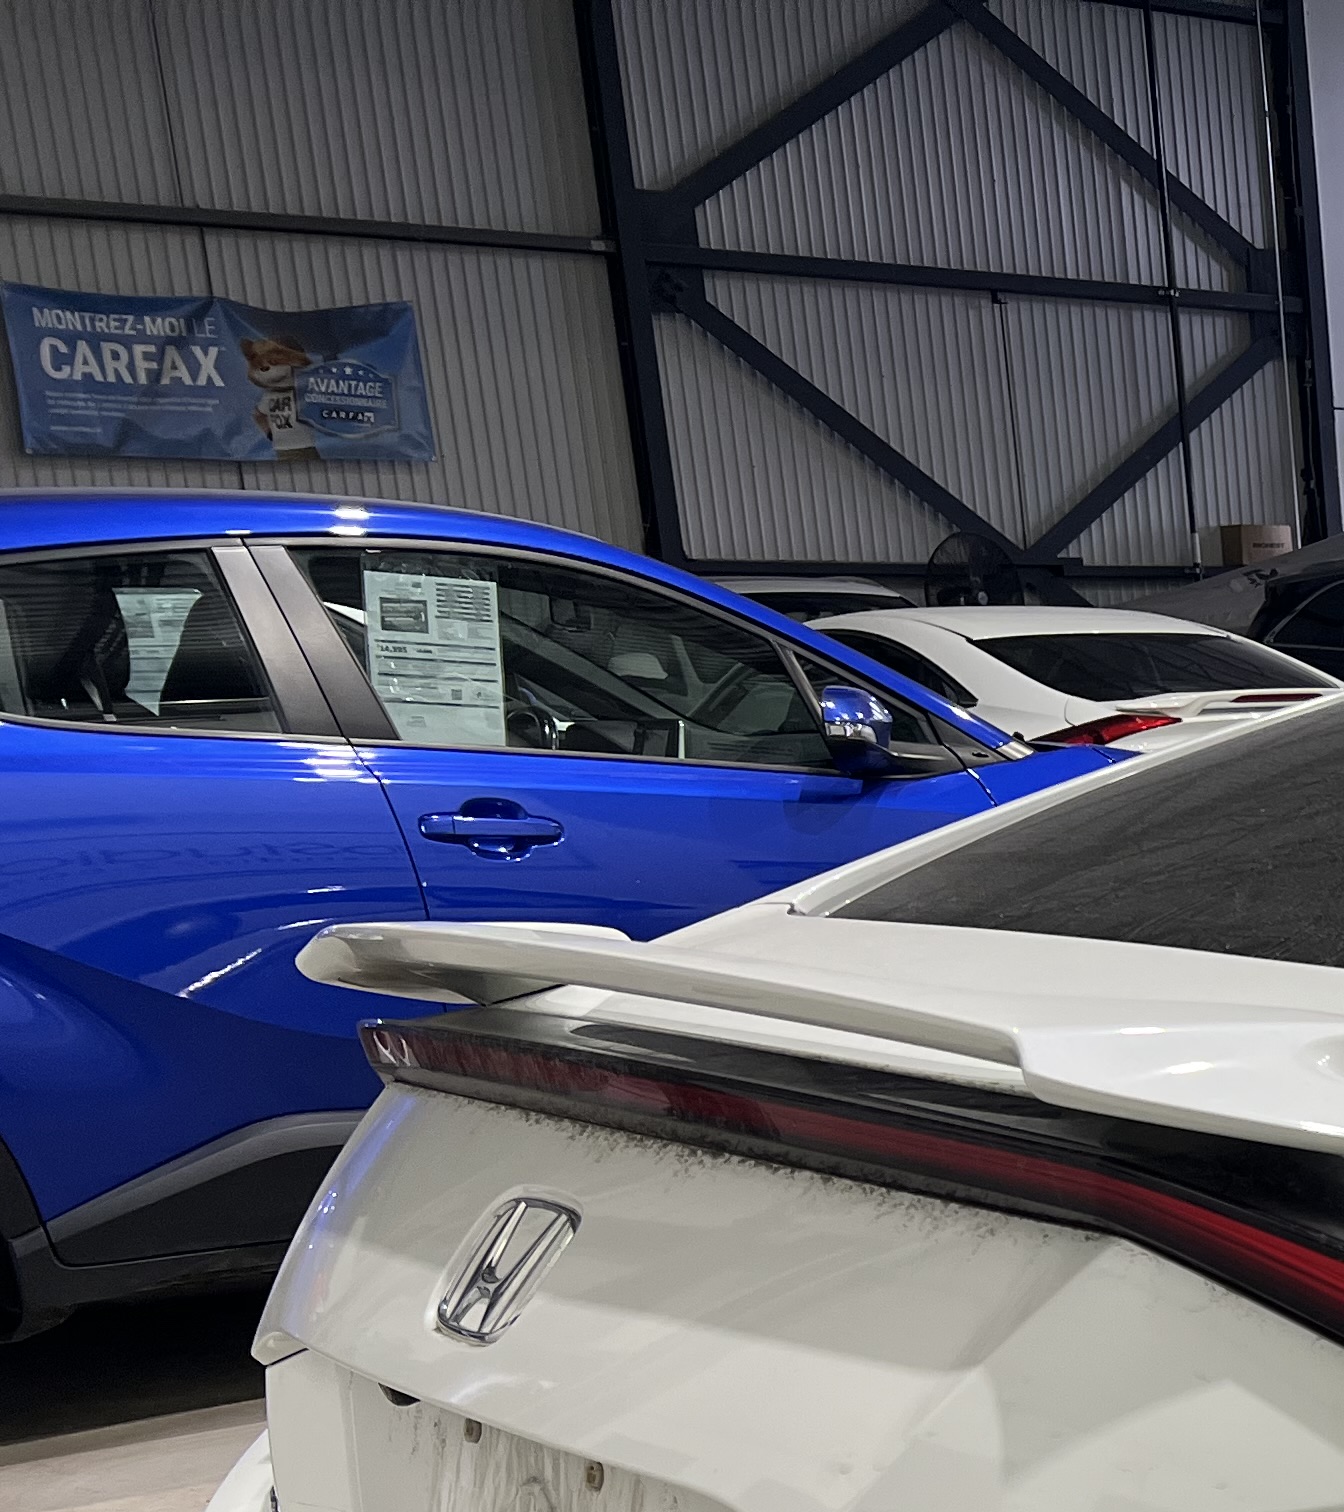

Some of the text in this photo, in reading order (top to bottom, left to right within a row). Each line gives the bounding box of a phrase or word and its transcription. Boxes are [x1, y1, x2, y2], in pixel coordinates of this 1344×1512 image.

[32, 306, 218, 338] MONTREZ-MOI LE
[39, 336, 225, 387] CARFAX
[307, 377, 384, 397] AVANTAGE
